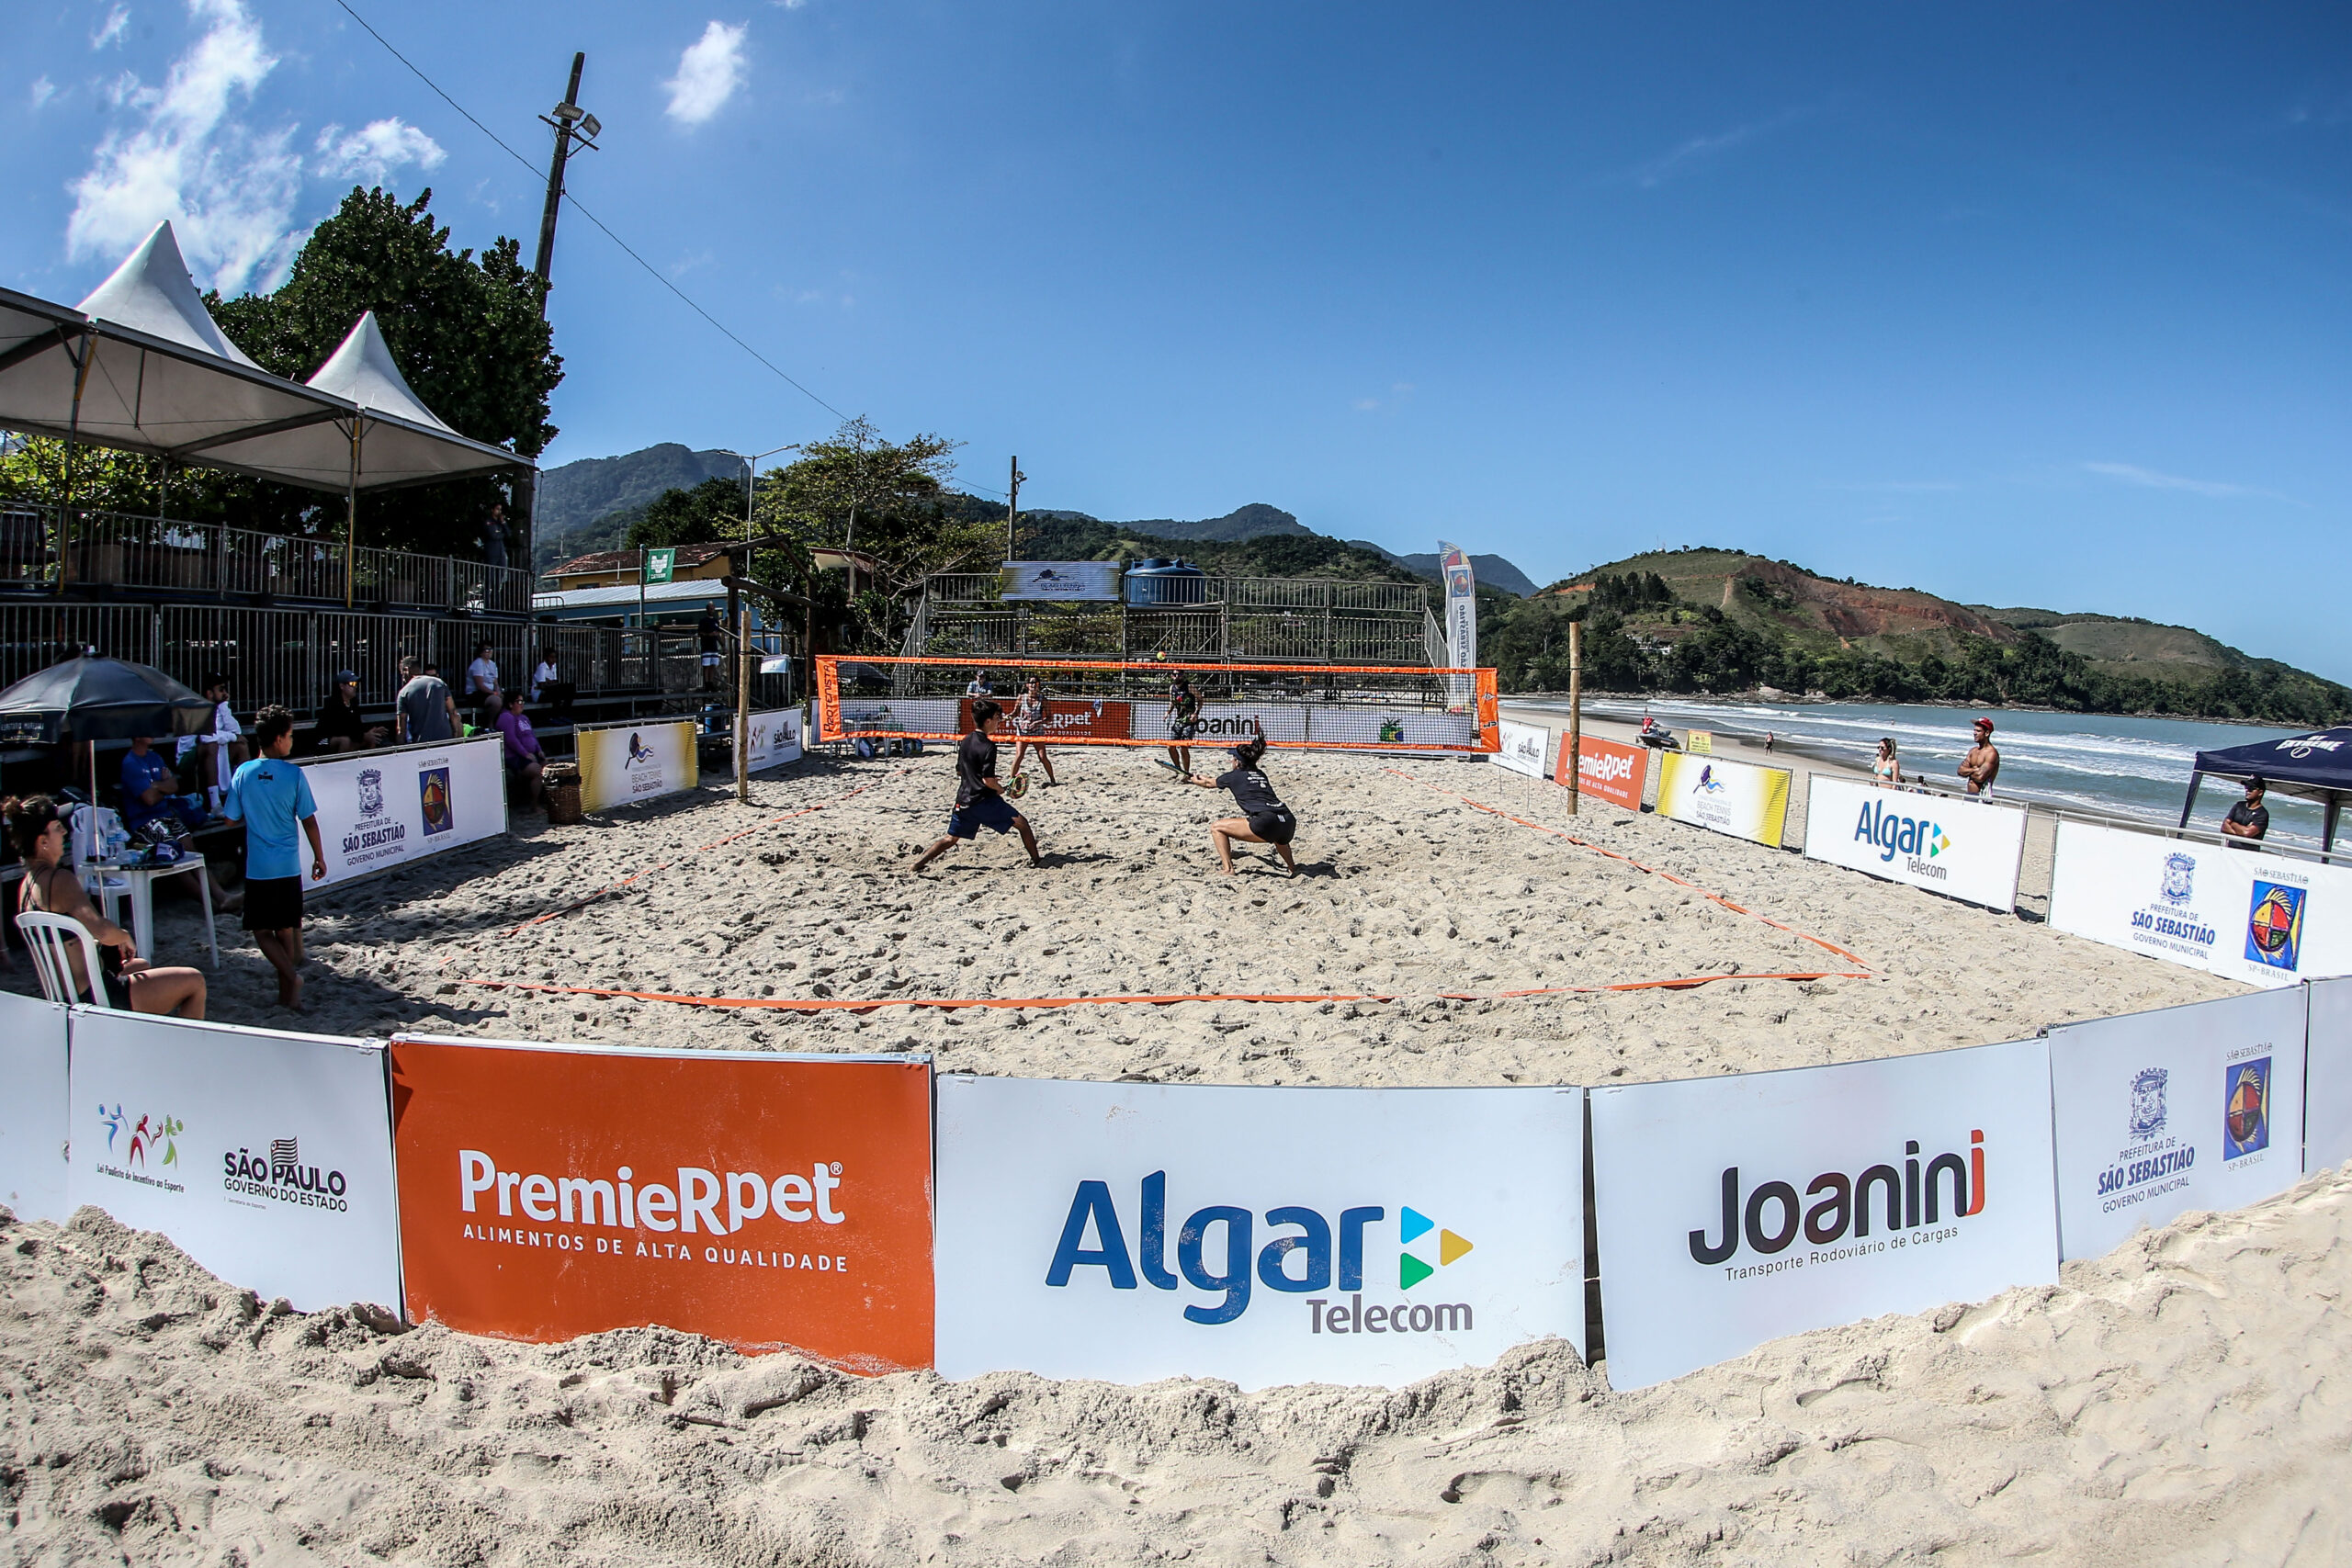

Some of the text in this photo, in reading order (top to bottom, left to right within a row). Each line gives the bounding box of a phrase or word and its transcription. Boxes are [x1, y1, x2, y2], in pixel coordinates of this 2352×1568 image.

[1194, 715, 1261, 736] oanini
[343, 821, 405, 853] SÃO SEBASTIÃO
[355, 817, 391, 832] PREFEITURA DE
[1854, 799, 1929, 862] Algar
[347, 845, 405, 866] GOVERNO MUNICIPAL
[1907, 856, 1947, 880] Telecom
[2131, 908, 2216, 945] SÃO SEBASTIÃO
[2150, 903, 2199, 921] PREFEITURA DE
[2133, 932, 2209, 960] GOVERNO MUNICIPAL
[2119, 1135, 2177, 1162] PREFEITURA DE
[105, 1165, 125, 1179] Paulista
[125, 1169, 132, 1180] de
[132, 1171, 155, 1187] Incentivo
[156, 1179, 164, 1189] ao
[164, 1179, 184, 1193] Esporte
[224, 1147, 346, 1197] SÃO PAULO
[2097, 1144, 2196, 1196] SÃO SEBASTIÃO
[224, 1178, 348, 1213] GOVERNO DO ESTADO
[2102, 1176, 2190, 1213] GOVERNO MUNICIPAL
[463, 1224, 848, 1273] ALIMENTOS DE ALTA QUALIDADE
[1045, 1169, 1385, 1325] Algar
[1725, 1226, 1960, 1282] Transporte Rodoviário de Cargas
[1306, 1294, 1473, 1334] Telecom
